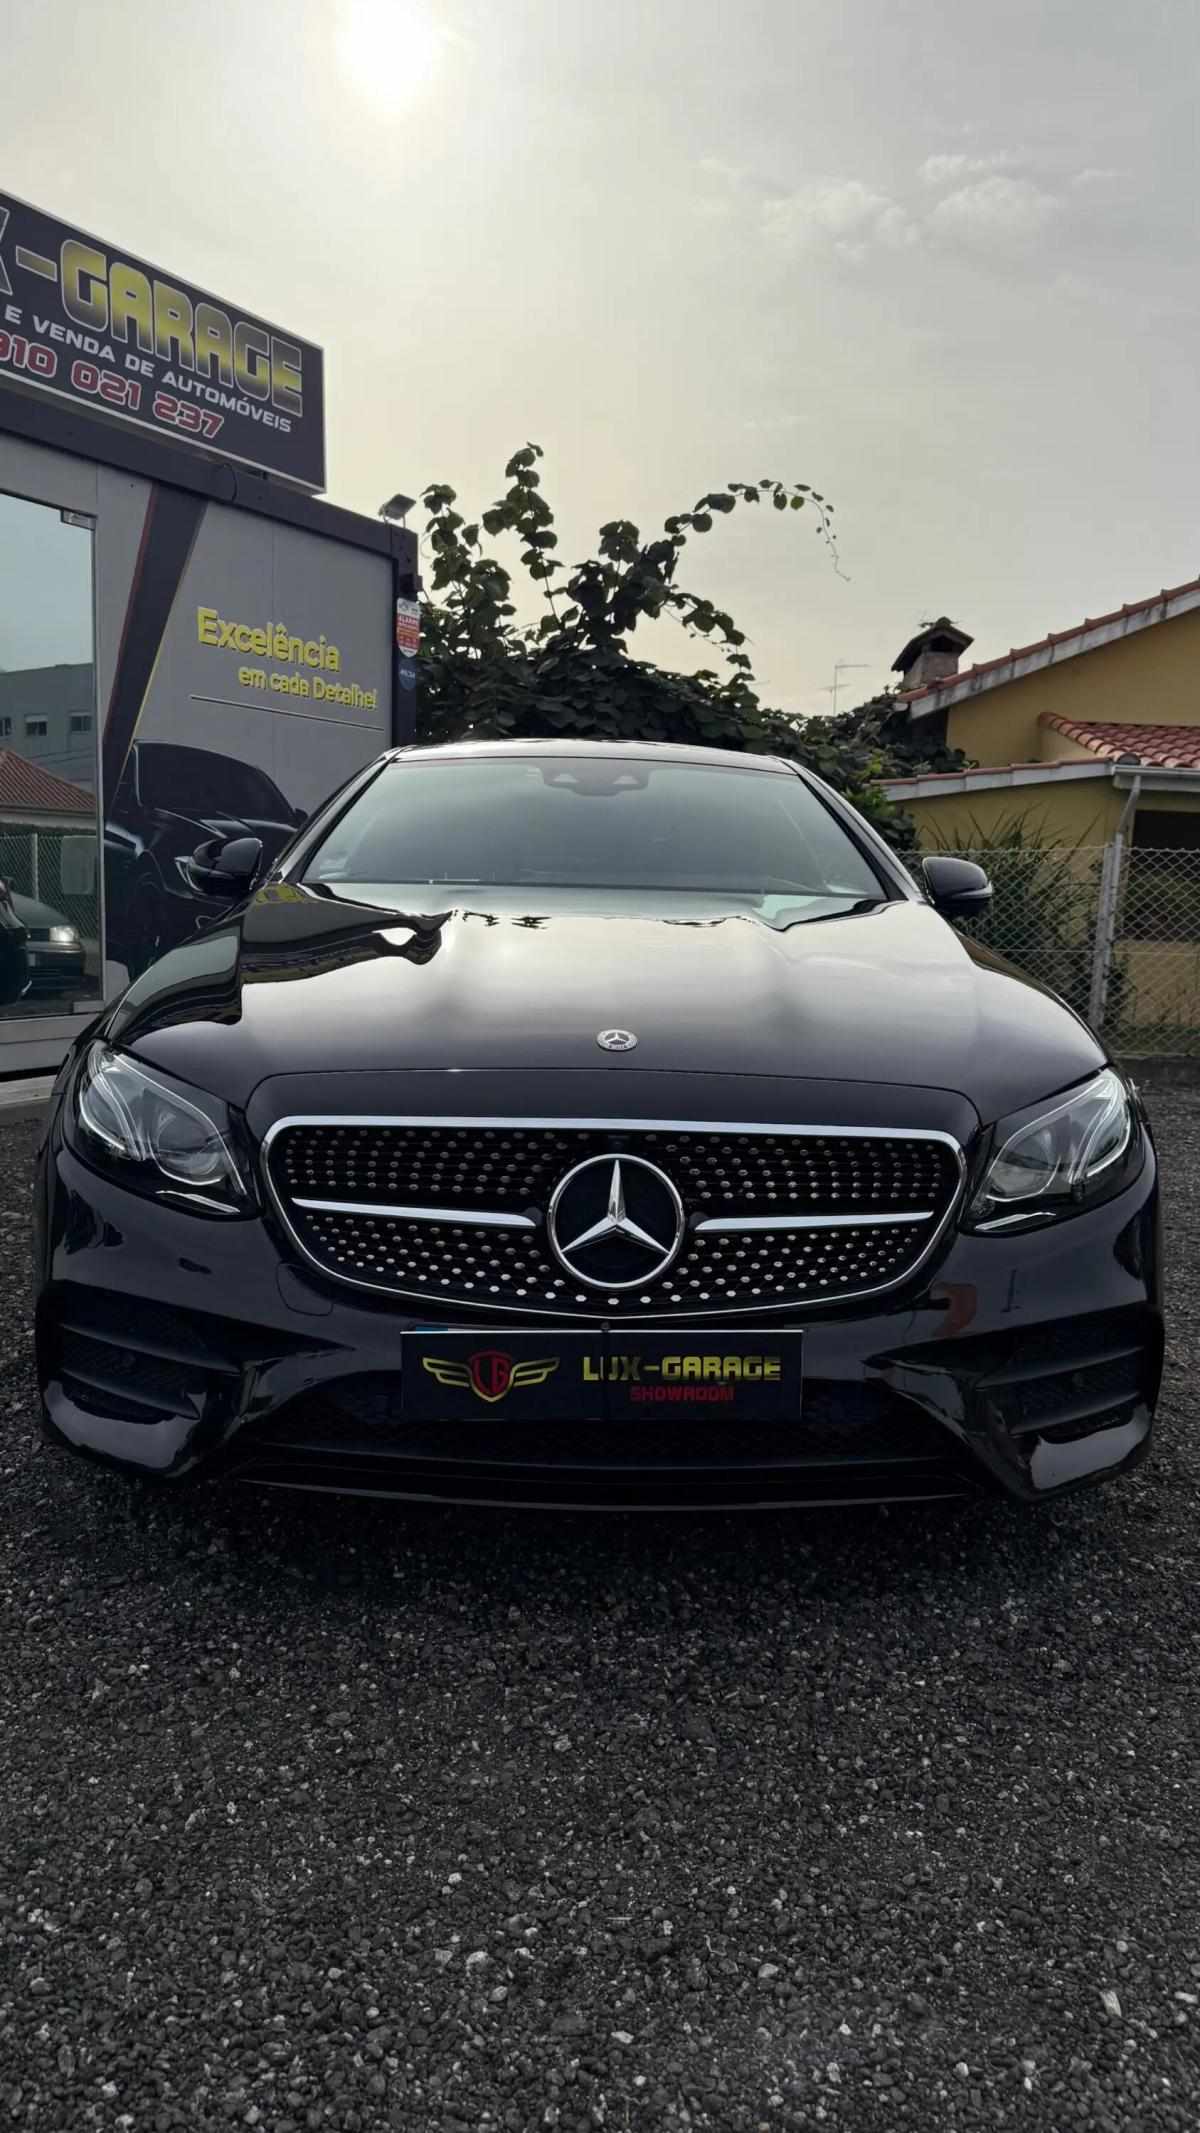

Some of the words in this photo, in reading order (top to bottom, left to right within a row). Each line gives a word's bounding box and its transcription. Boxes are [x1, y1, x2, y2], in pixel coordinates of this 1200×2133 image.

[4, 304, 23, 325] E
[32, 315, 116, 362] VENDA
[125, 353, 155, 377] DE
[161, 371, 292, 432] AUTOMÓVEIS
[71, 359, 142, 411] 021
[152, 390, 224, 438] 237
[197, 606, 341, 673] Excelência
[238, 667, 266, 690] em
[270, 672, 310, 697] cada
[312, 676, 378, 711] Detalhe!
[583, 1356, 782, 1381] LUX-GARAGE
[630, 1384, 735, 1402] SHOWROOM
